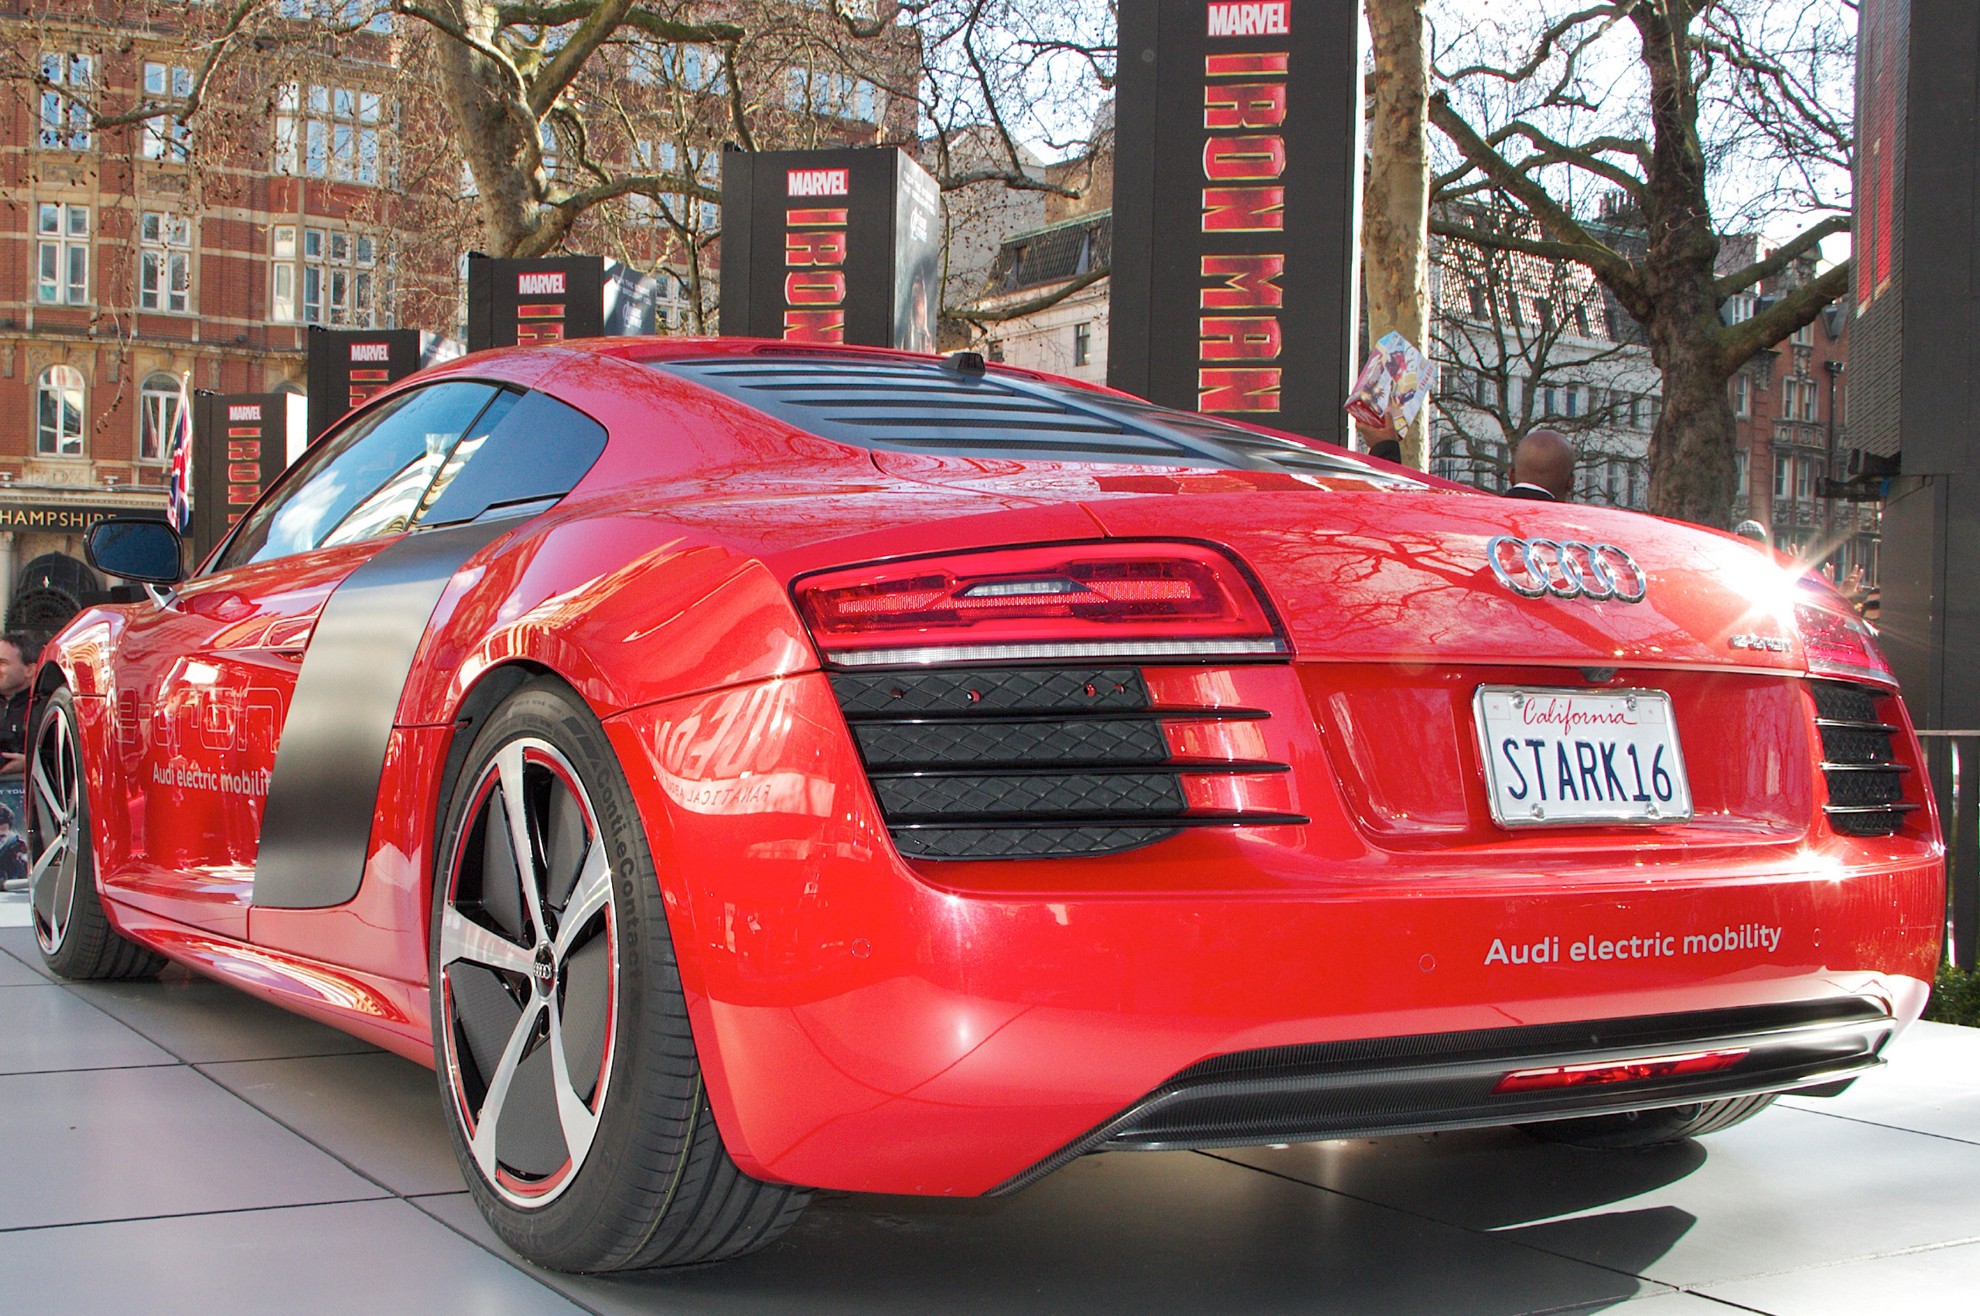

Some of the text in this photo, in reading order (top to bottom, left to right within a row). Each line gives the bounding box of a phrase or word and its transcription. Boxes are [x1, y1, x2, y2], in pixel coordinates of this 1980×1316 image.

[1208, 3, 1288, 36] MARVEL
[788, 171, 848, 197] MARVEL
[1198, 52, 1290, 412] IRON MAN
[519, 274, 565, 294] MARVEL
[783, 208, 849, 344] IRON
[351, 345, 389, 361] MARVEL
[229, 406, 261, 420] MARVEL
[228, 427, 262, 504] IRON
[1523, 697, 1637, 735] California
[153, 762, 174, 785] Audi
[176, 767, 217, 791] electric
[1502, 738, 1672, 801] STARK16
[1484, 923, 1782, 965] Audi electric mobility
